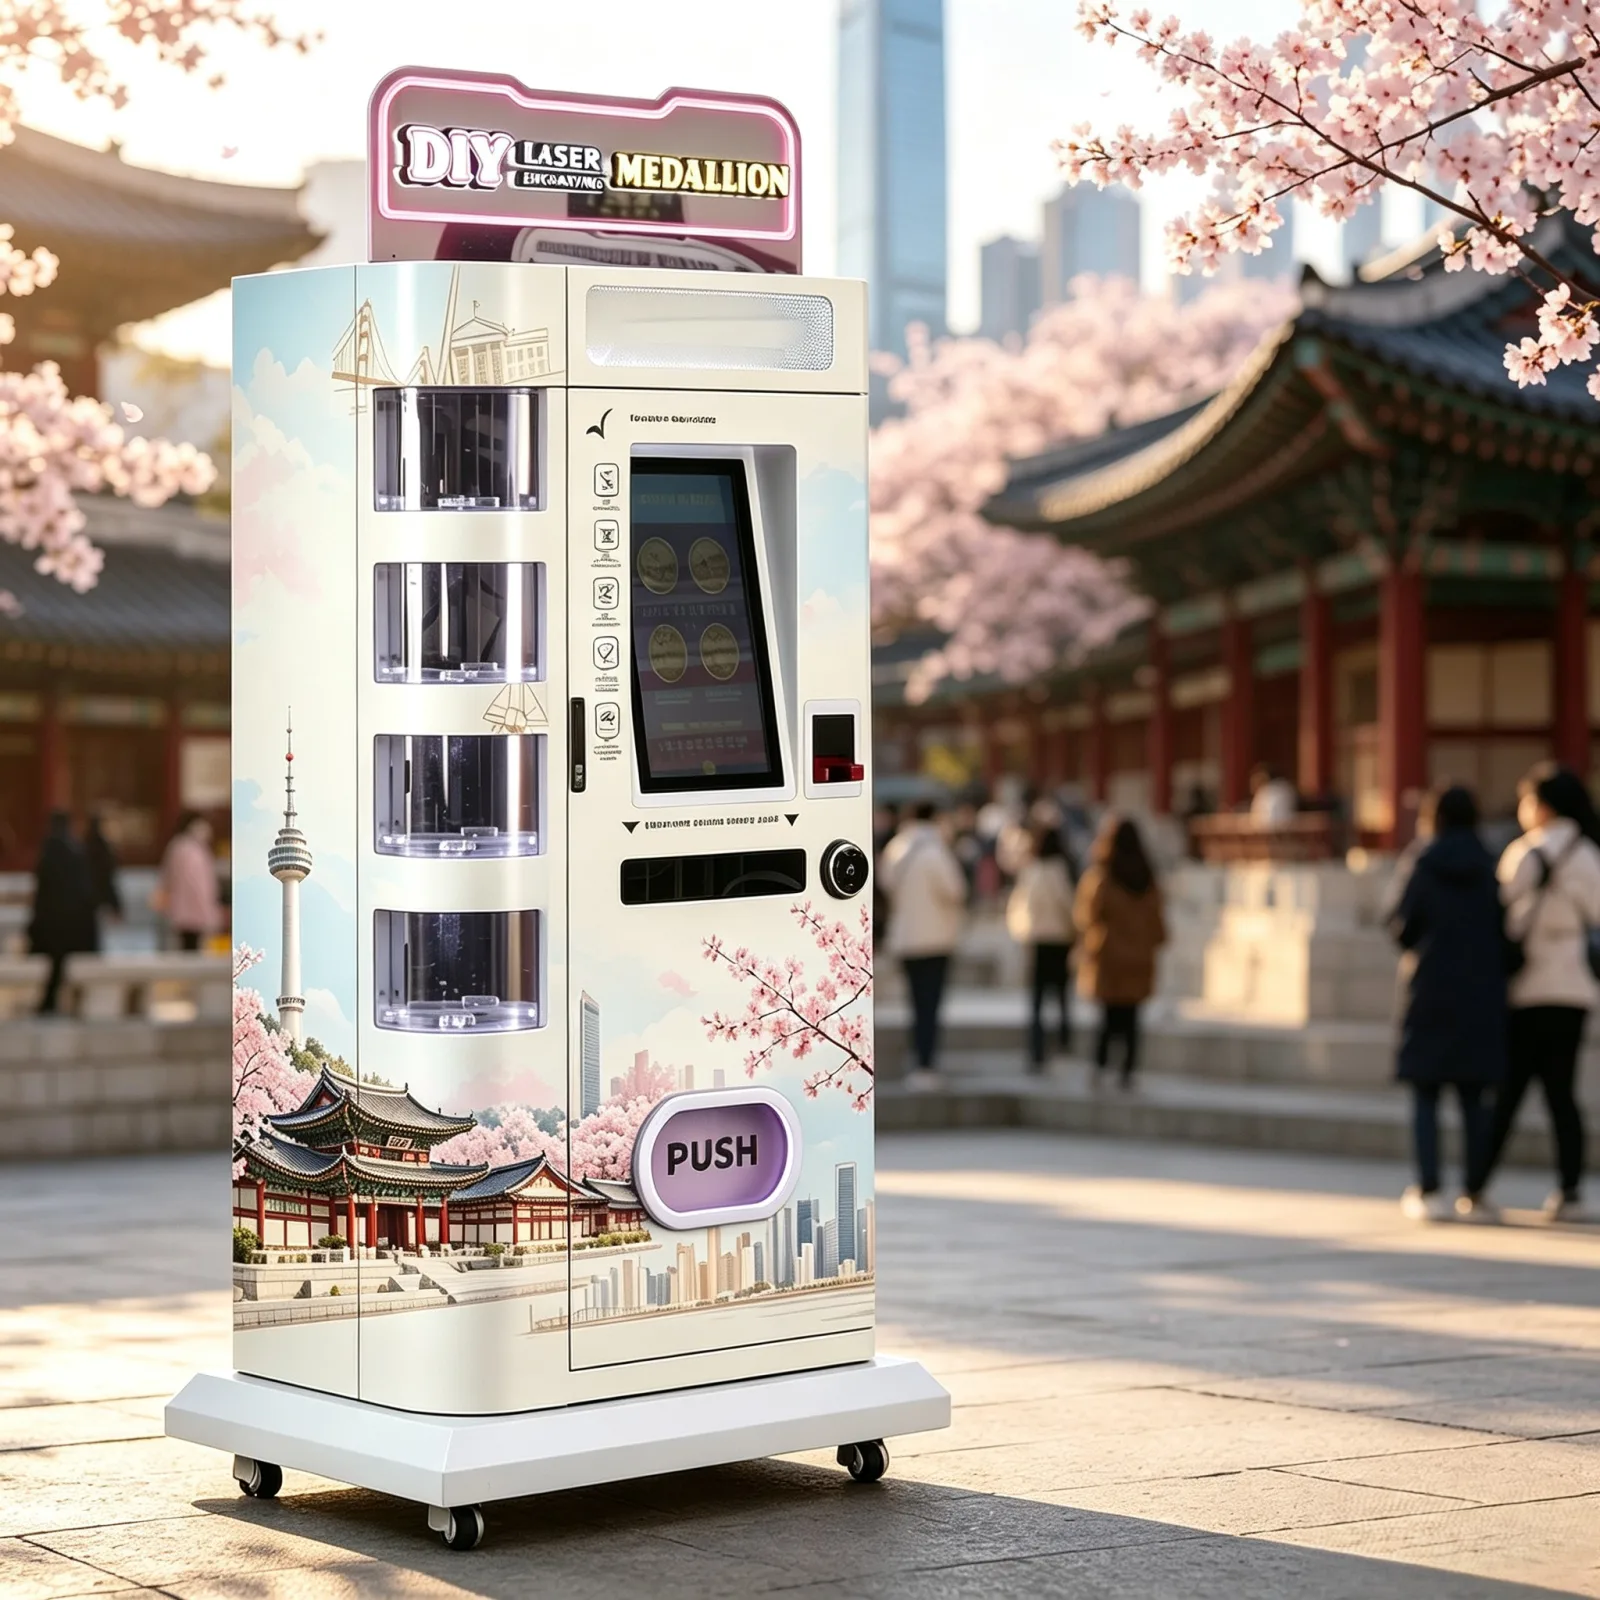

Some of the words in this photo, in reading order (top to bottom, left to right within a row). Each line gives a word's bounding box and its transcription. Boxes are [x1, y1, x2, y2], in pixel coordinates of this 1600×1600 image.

[402, 124, 515, 189] DIY
[523, 141, 602, 171] LASER
[614, 152, 790, 197] MEDALLION
[667, 1134, 758, 1176] PUSH
